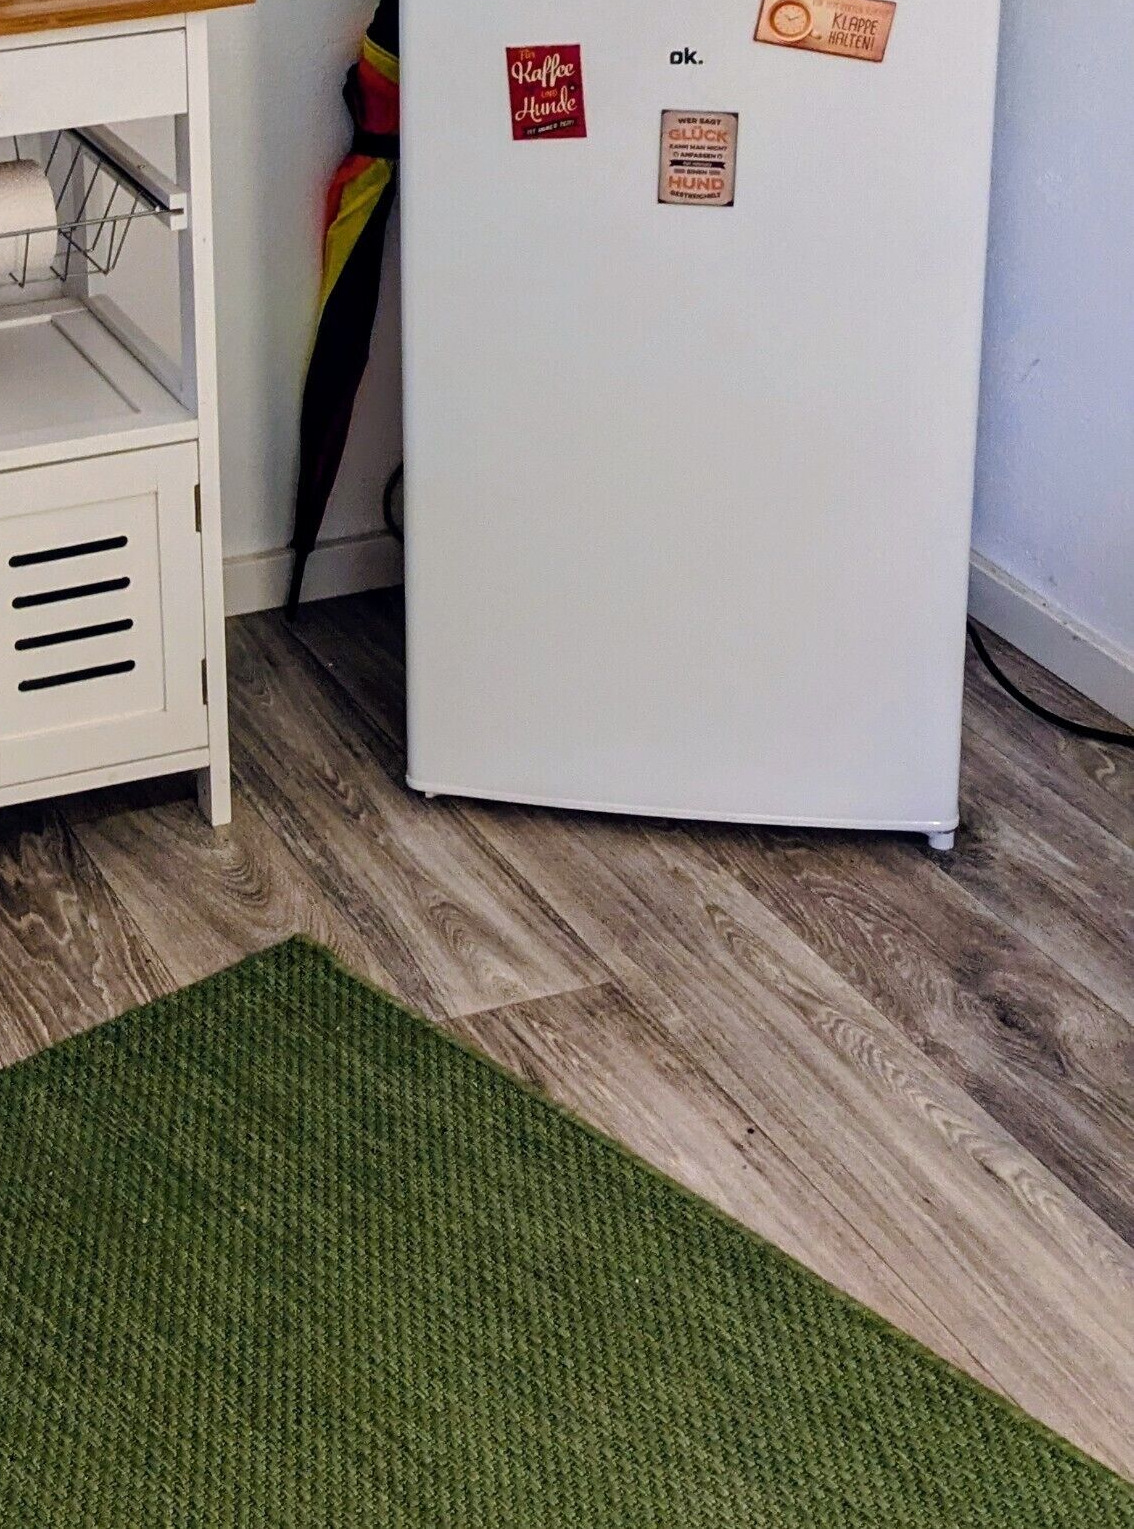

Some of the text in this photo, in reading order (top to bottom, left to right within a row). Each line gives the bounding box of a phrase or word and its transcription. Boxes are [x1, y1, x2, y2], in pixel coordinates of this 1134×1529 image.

[832, 12, 878, 35] KLAPPE
[670, 47, 704, 65] ok.
[511, 53, 575, 87] Kaffee
[514, 85, 578, 123] Hunde
[668, 126, 729, 143] GLÜCK
[668, 175, 725, 191] HUND
